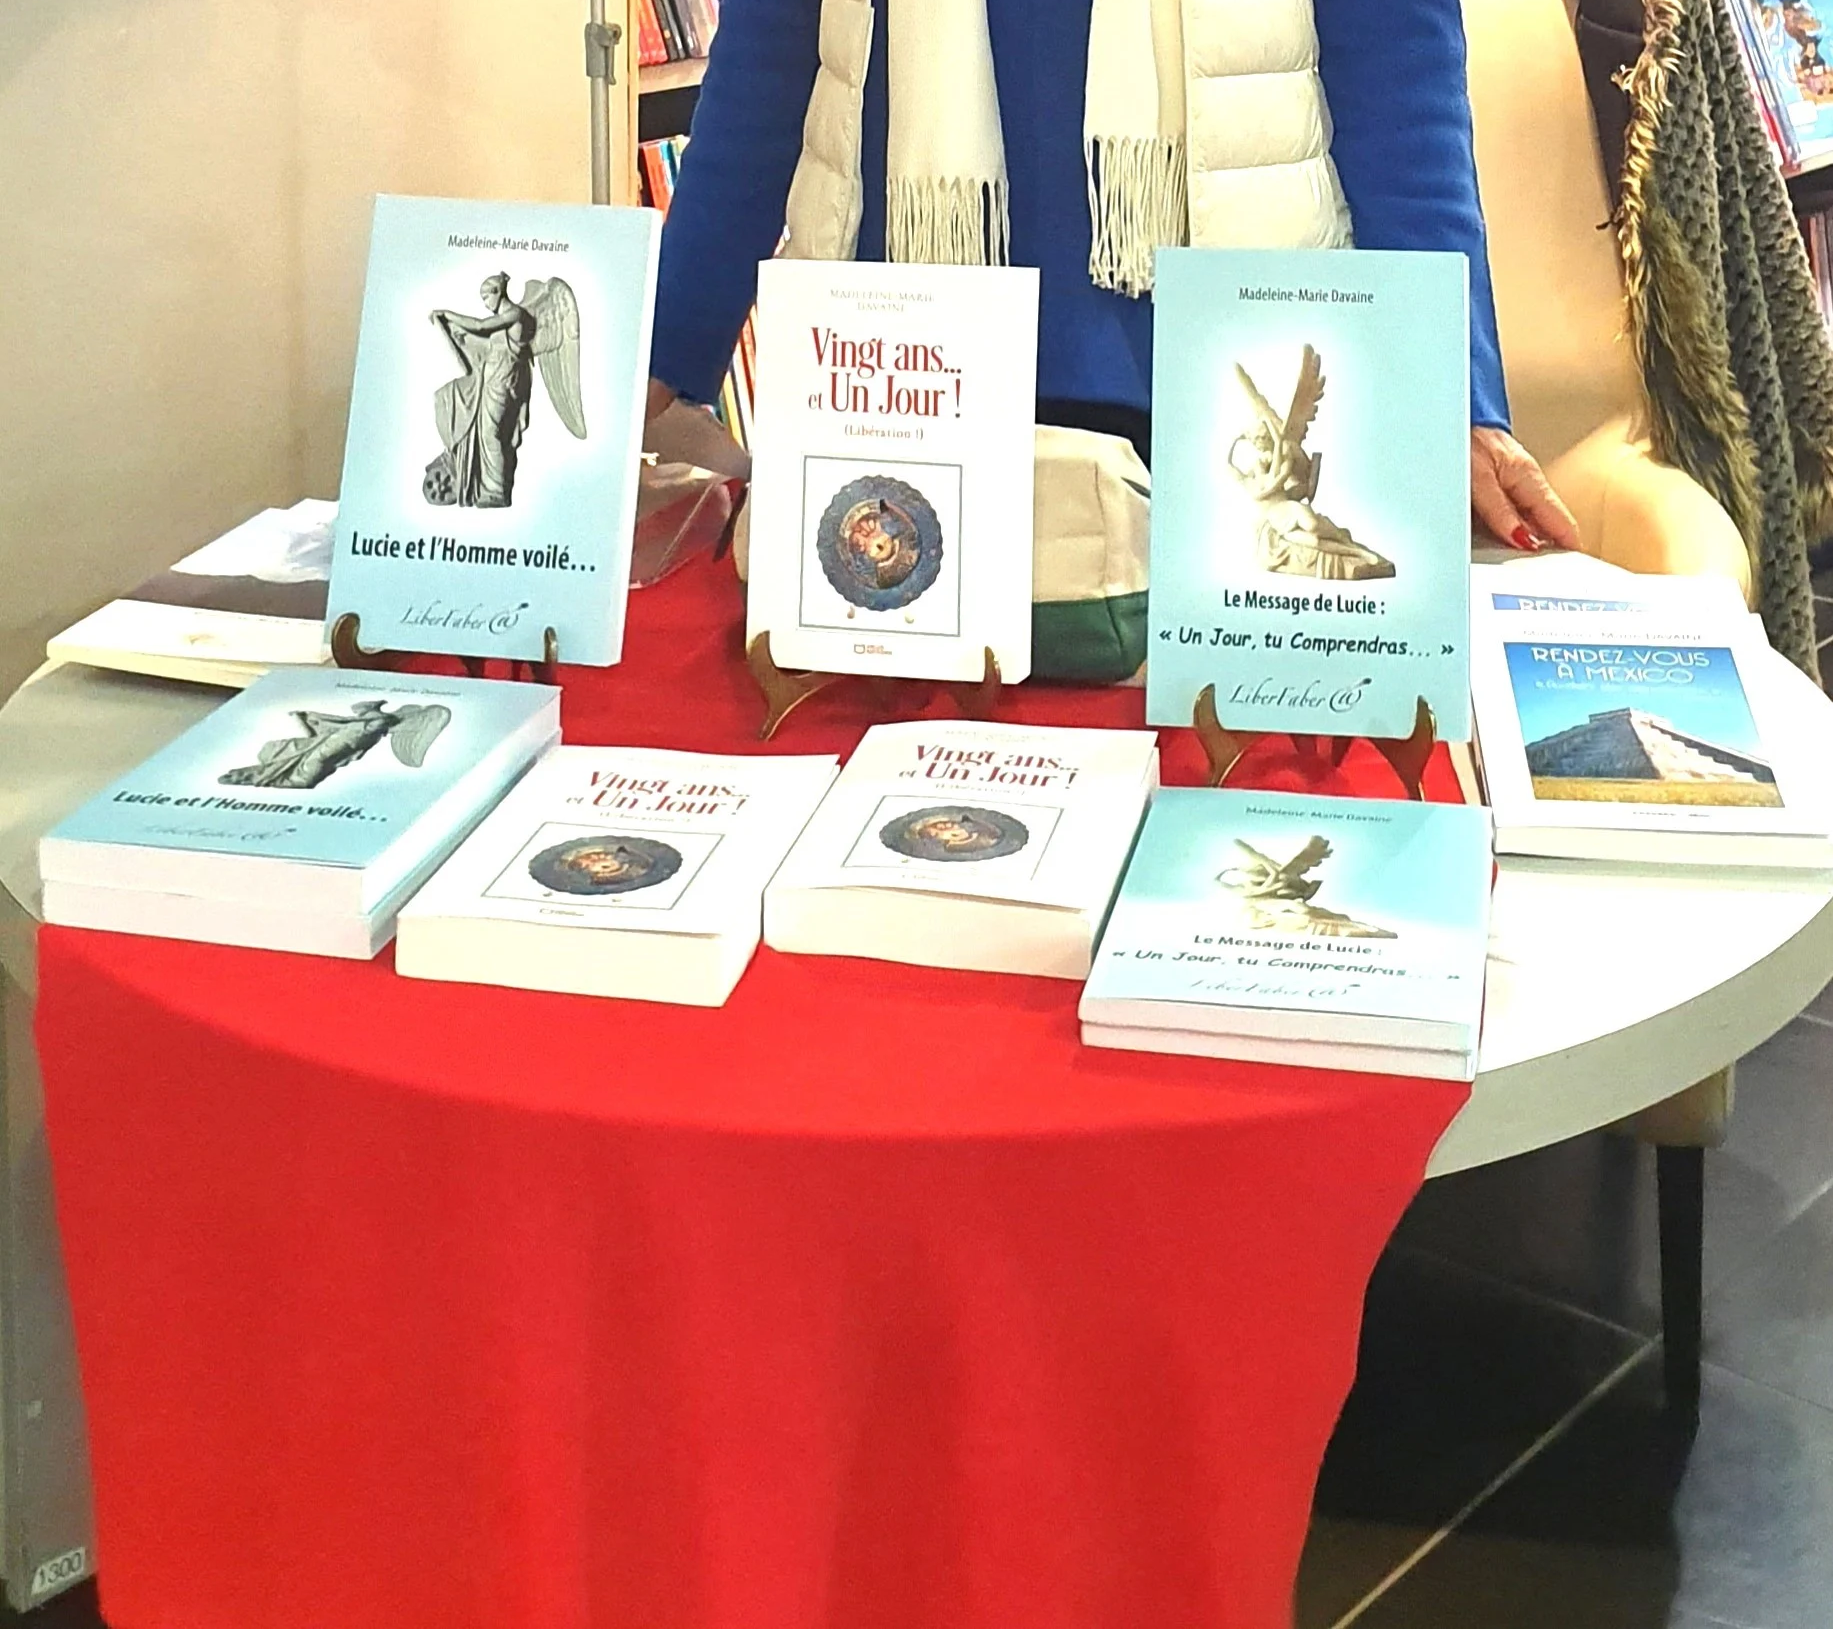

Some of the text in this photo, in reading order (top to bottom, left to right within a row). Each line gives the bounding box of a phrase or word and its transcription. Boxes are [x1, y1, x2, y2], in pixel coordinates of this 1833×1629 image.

[448, 234, 570, 253] Madeleine-Marie Davaine
[1238, 287, 1375, 305] Madeleine-Marie Davaine
[811, 326, 962, 378] Vingt ans...
[808, 372, 963, 419] et Un Jour !
[844, 423, 910, 440] (Libération
[351, 531, 596, 572] Lucie et l'Homme voilé...
[1224, 588, 1376, 615] Le Message de Lucie
[1179, 627, 1203, 646] Un
[1209, 628, 1257, 652] Jour,
[1264, 632, 1283, 649] tu
[1290, 632, 1431, 658] Comprendras...
[1531, 646, 1711, 668] RENDEZ-VOUS
[1556, 661, 1694, 684] À MEXICO
[916, 744, 1000, 767] Vingt
[590, 771, 670, 795] Vingt
[925, 762, 971, 781] Un
[978, 766, 1059, 787] Jour
[112, 790, 387, 823] Lucie et l'Homme voilé...
[592, 789, 640, 810] Un
[645, 795, 728, 814] Jour
[1194, 934, 1373, 956] Le Message de Lucie
[1135, 949, 1164, 961] Un
[1237, 957, 1259, 967] tu
[38, 1552, 82, 1586] 1300
